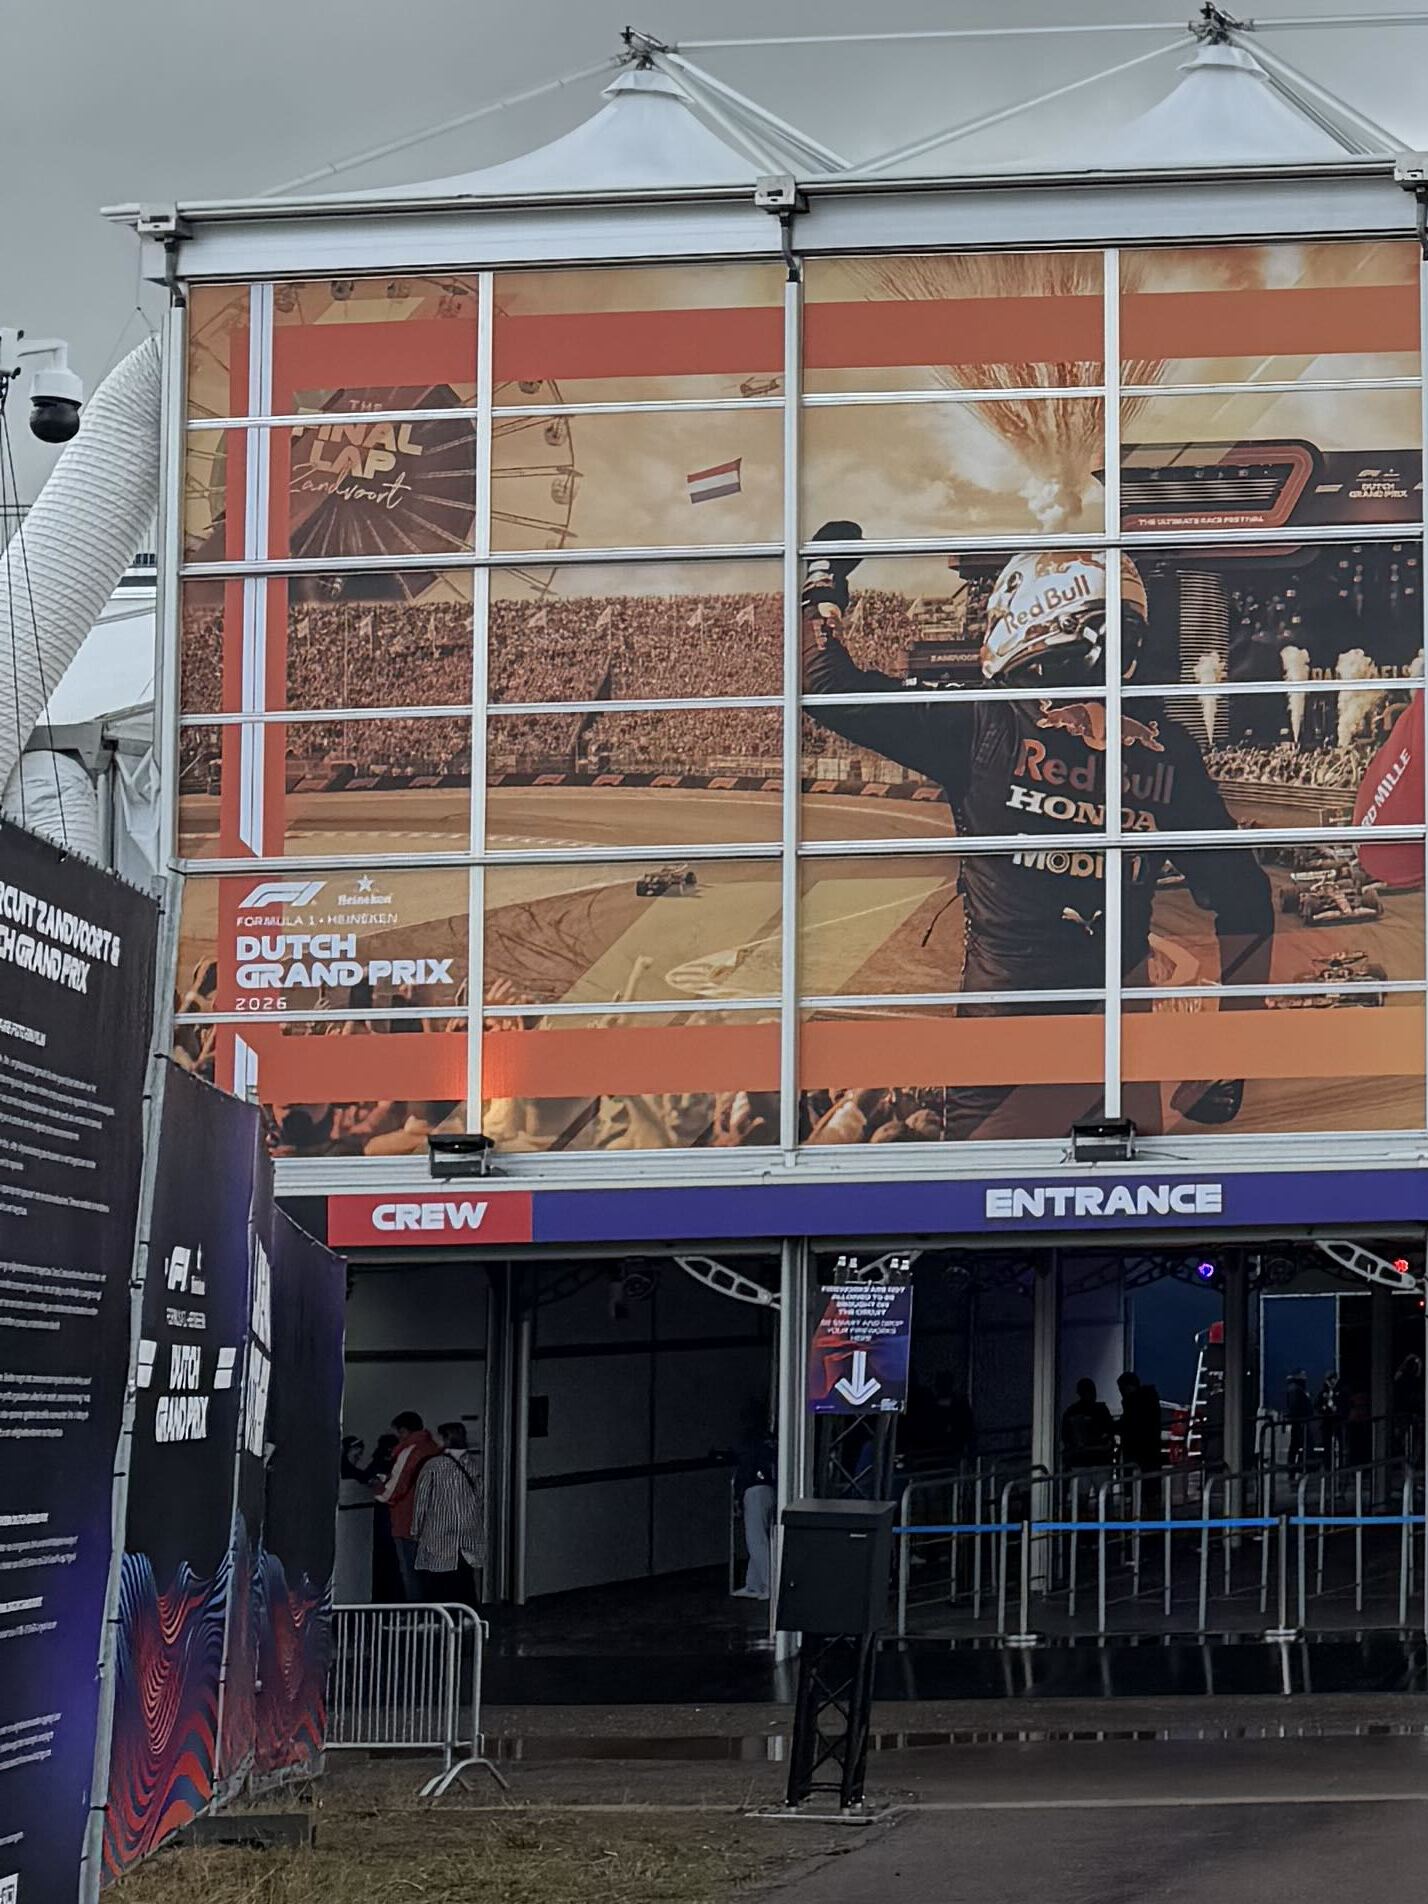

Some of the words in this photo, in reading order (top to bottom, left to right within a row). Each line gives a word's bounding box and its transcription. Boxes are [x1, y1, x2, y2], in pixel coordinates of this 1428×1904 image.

[309, 439, 397, 479] LAP
[1003, 594, 1044, 634] Red
[1044, 574, 1091, 610] Bull
[0, 881, 37, 928] CUIT
[36, 900, 113, 962] ZANDVOORT
[236, 915, 303, 927] FORMULA
[16, 933, 62, 982] GRAND
[61, 952, 91, 995] PRIX
[236, 934, 357, 961] DUTCH
[236, 961, 364, 989] GRAND
[368, 958, 454, 986] PRIX
[235, 997, 287, 1011] 2026
[372, 1201, 488, 1231] CREW
[985, 1183, 1222, 1218] ENTRANCE
